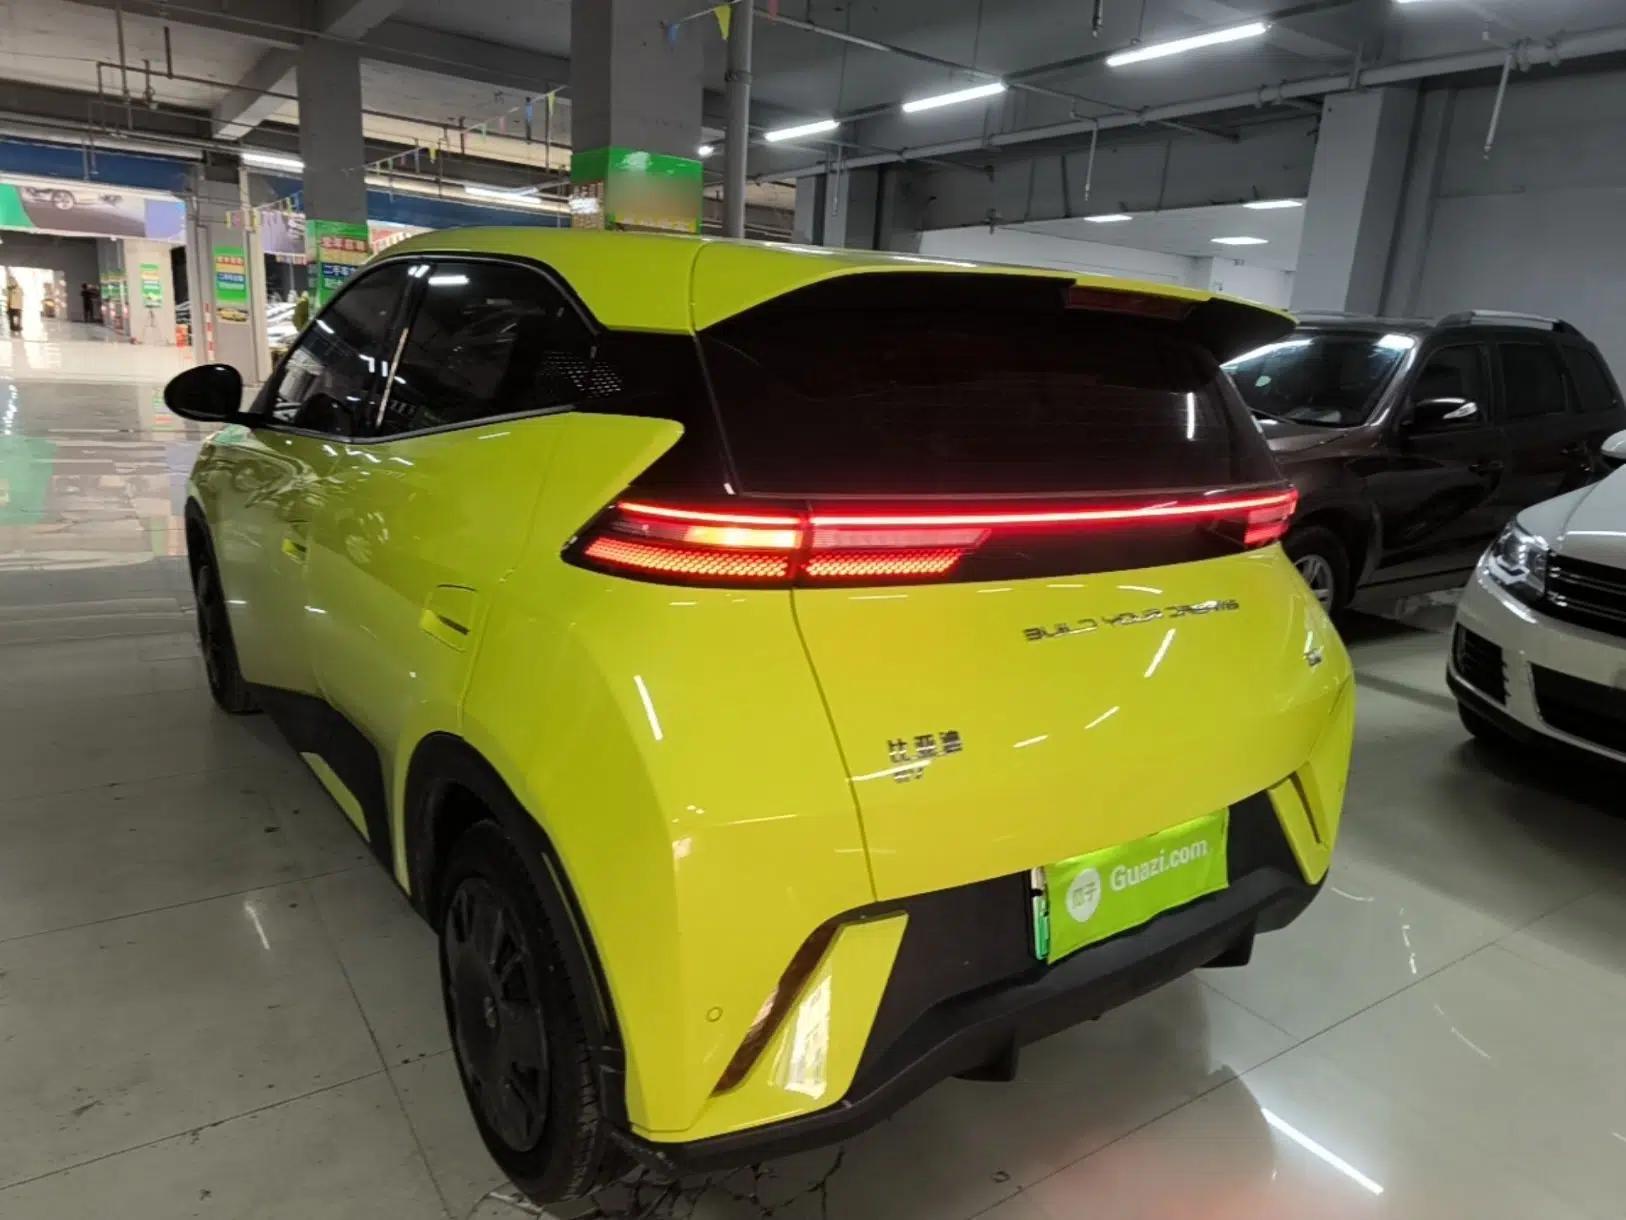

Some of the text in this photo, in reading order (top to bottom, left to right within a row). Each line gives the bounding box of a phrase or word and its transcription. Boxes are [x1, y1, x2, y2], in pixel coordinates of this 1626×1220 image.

[886, 729, 964, 764] 比亚迪
[1110, 839, 1209, 892] Guazi.com
